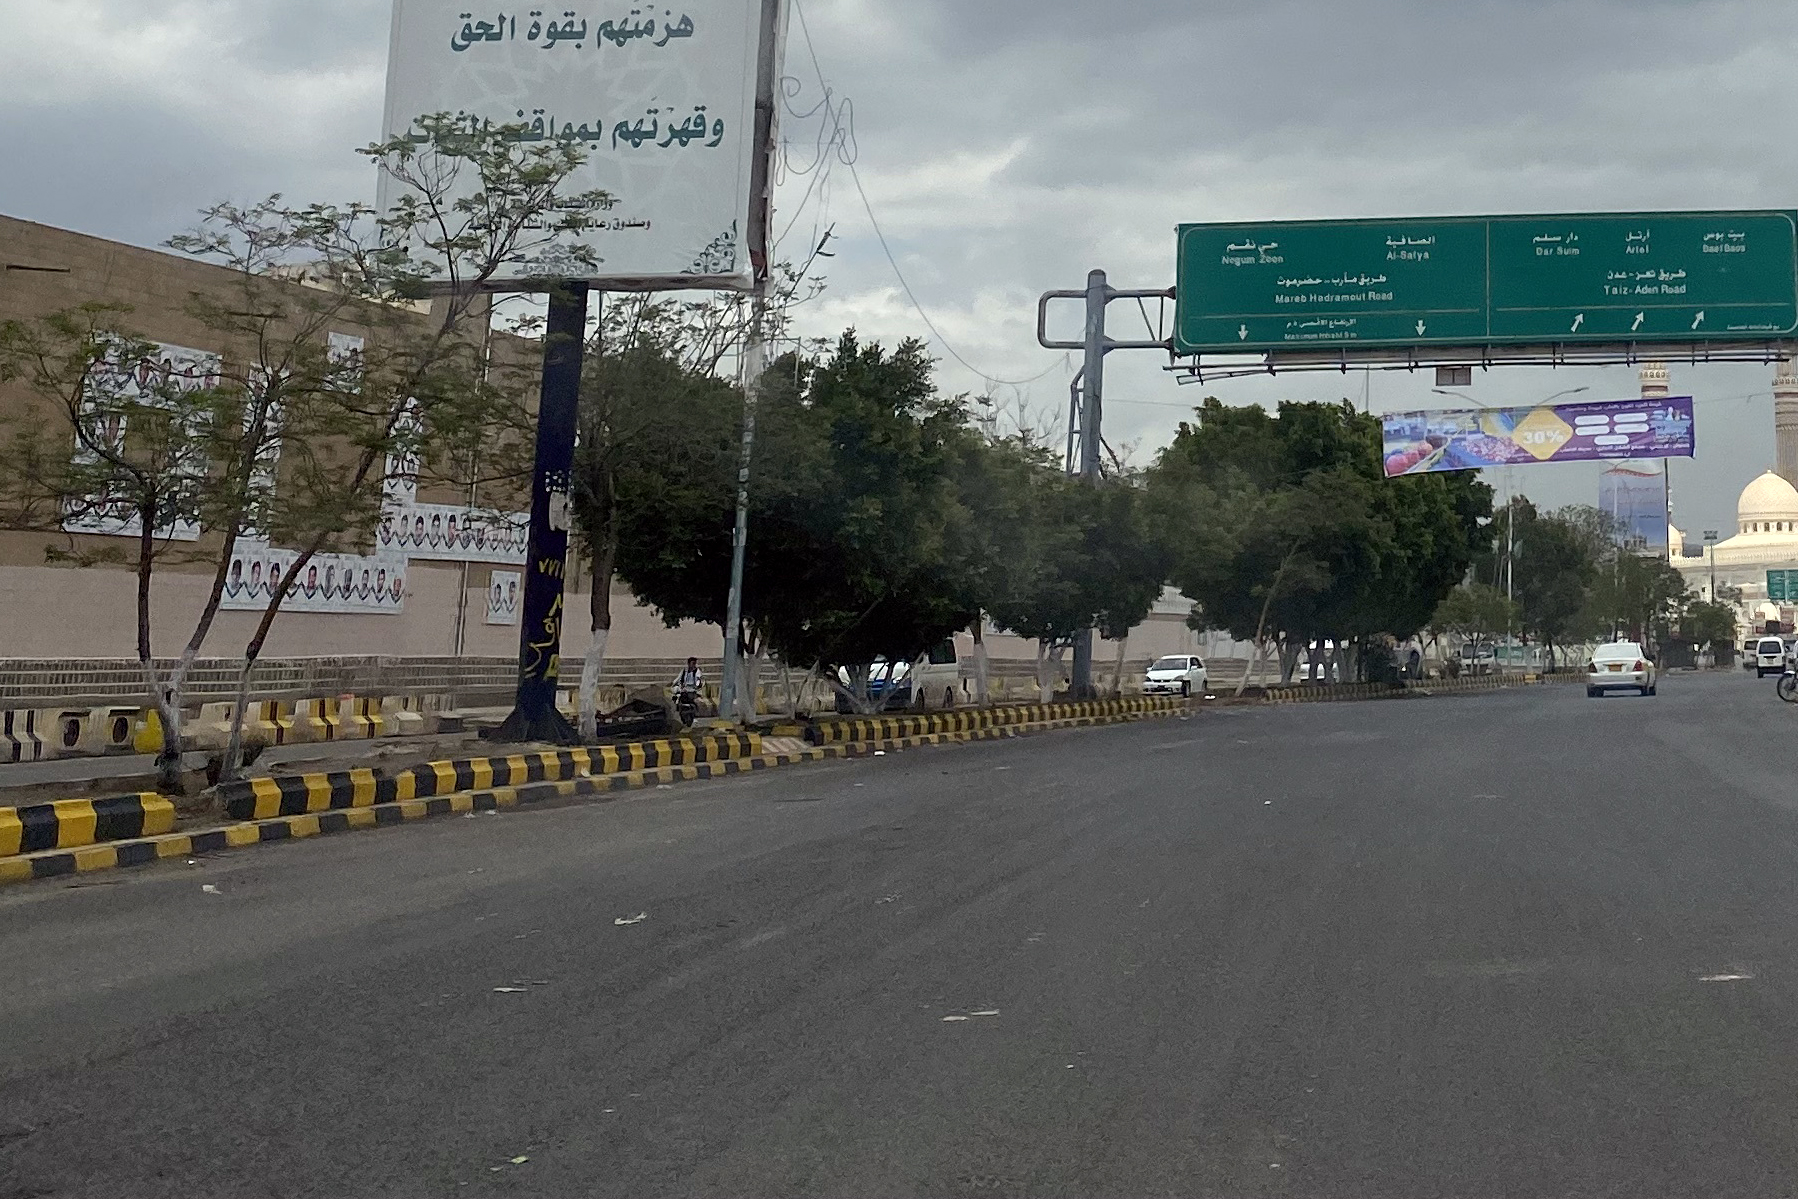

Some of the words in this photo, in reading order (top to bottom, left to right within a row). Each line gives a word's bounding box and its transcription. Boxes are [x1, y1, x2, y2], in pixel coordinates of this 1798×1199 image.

[451, 11, 517, 52] الحق
[541, 10, 588, 50] بقوة
[1386, 234, 1436, 249] الصافية
[1367, 290, 1394, 301] Road
[1660, 283, 1687, 295] Road
